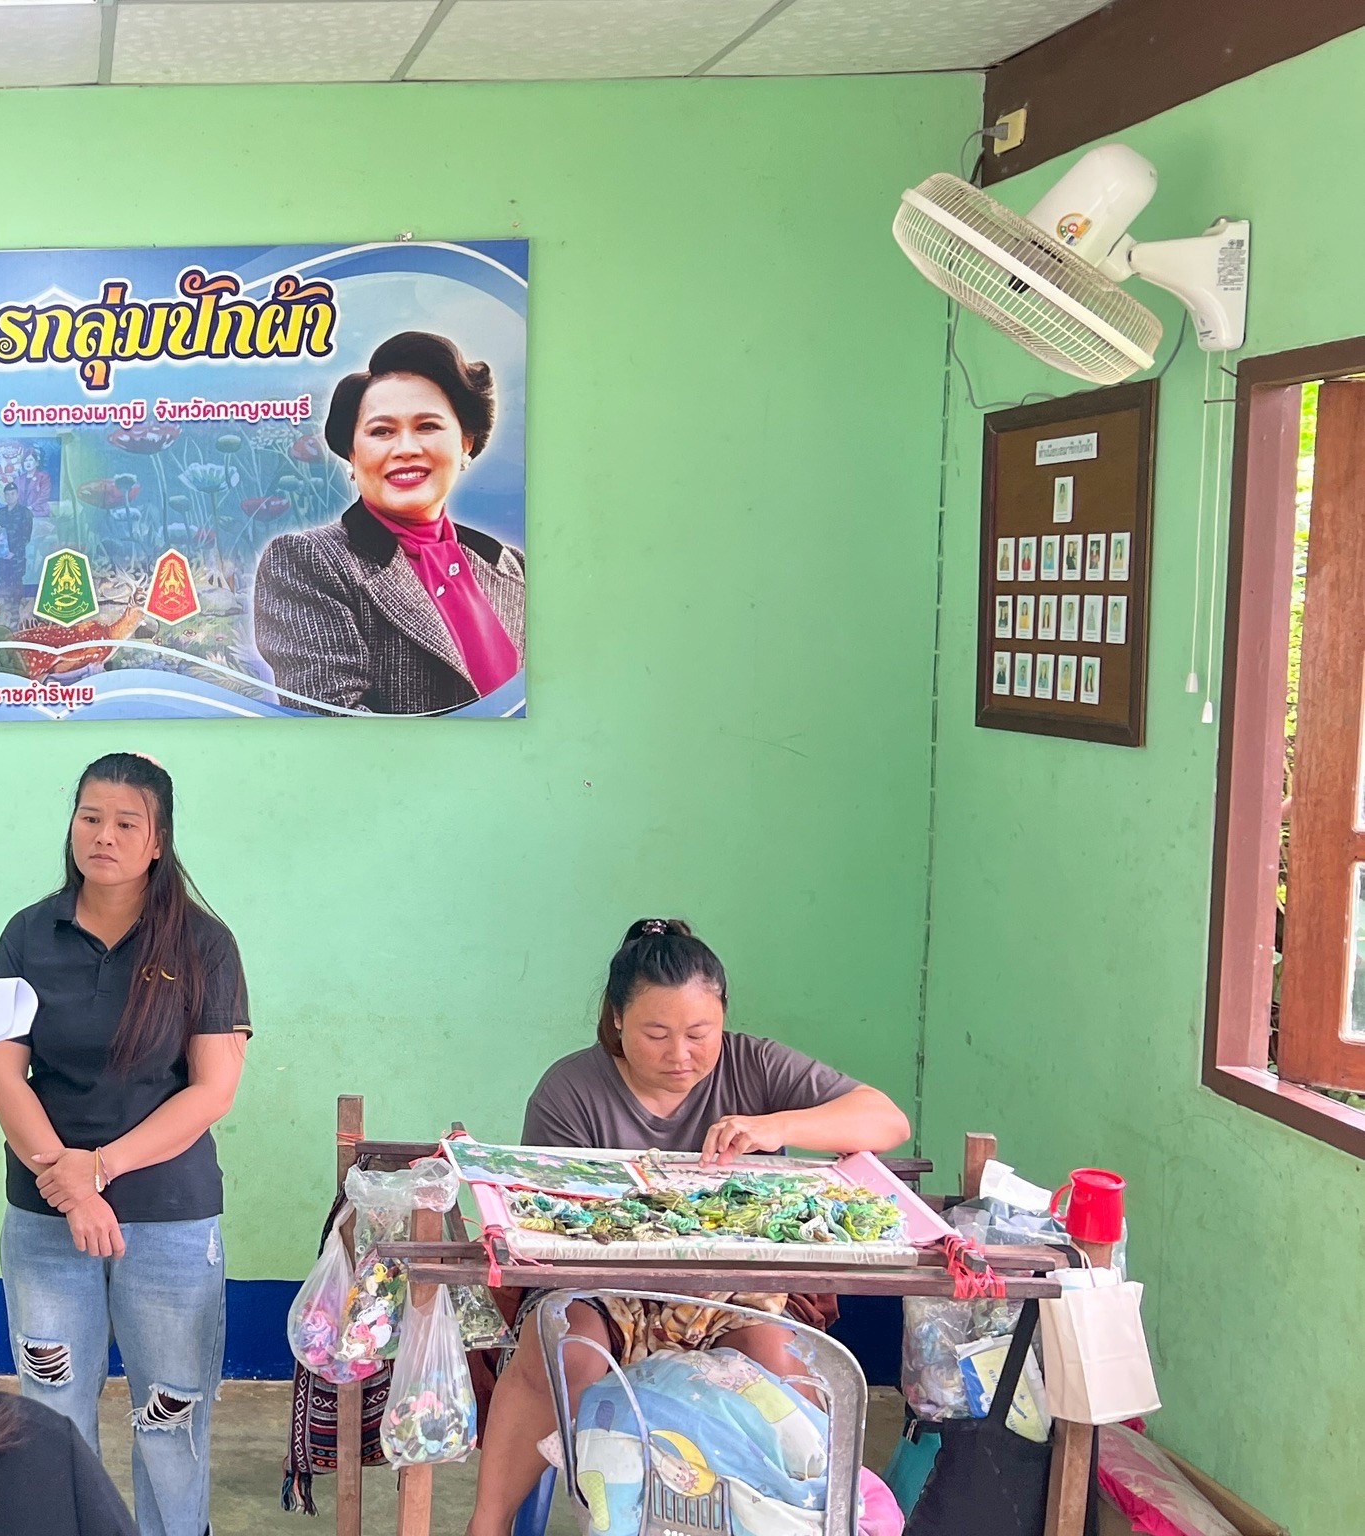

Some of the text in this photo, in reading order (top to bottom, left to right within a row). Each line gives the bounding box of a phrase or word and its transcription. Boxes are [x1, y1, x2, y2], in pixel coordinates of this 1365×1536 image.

[2, 401, 145, 426] อำเภอทองผาภูมิ
[155, 396, 310, 424] จังหวัดกาญจนบุรี
